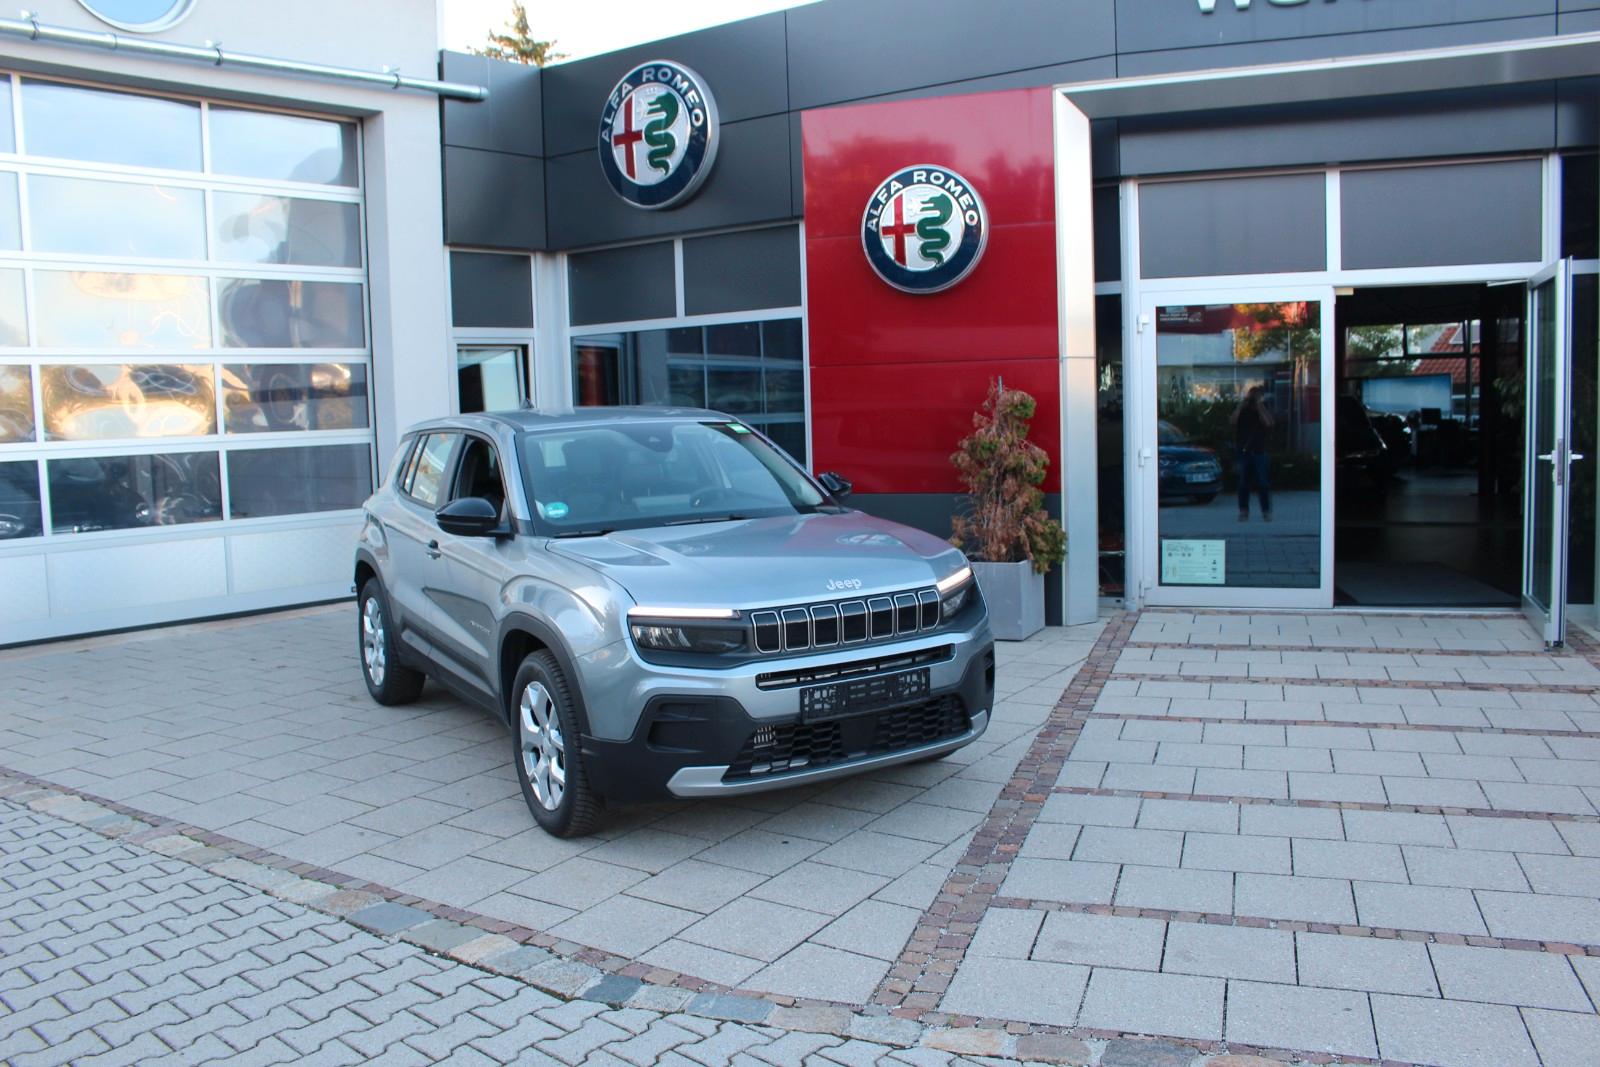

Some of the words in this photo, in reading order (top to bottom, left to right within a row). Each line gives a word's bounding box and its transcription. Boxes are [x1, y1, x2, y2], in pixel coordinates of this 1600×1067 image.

[601, 82, 633, 143] ALFA
[642, 67, 704, 127] ROMEO
[867, 179, 903, 232] ALFA
[912, 170, 978, 226] ROMEO
[826, 578, 862, 591] Jeep
